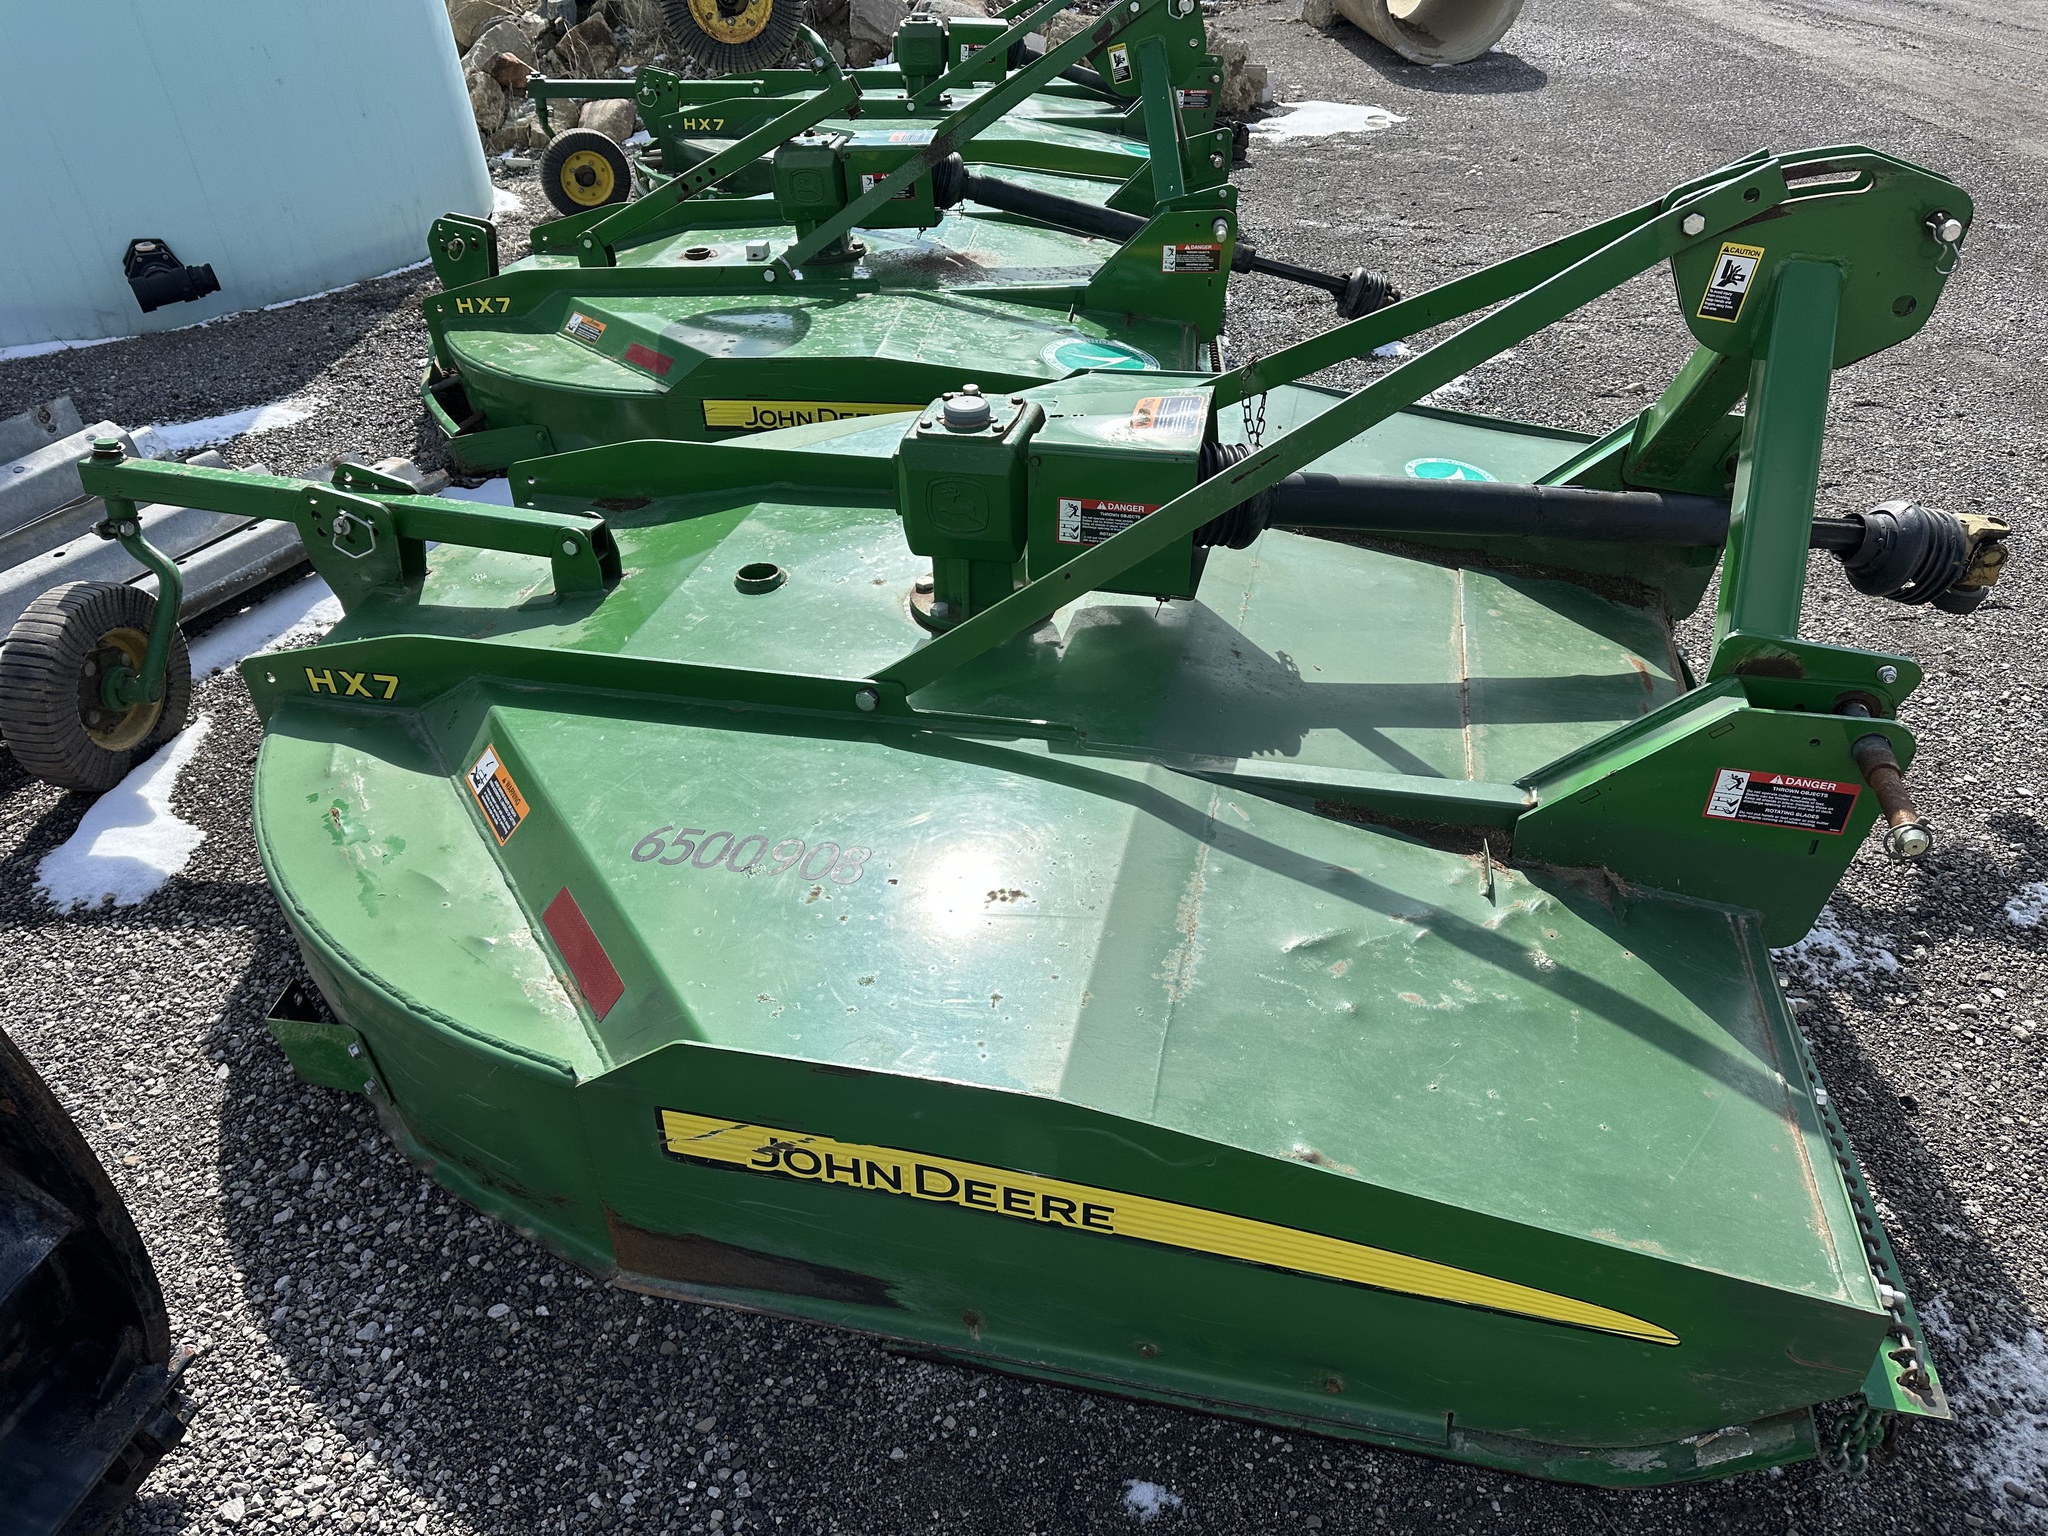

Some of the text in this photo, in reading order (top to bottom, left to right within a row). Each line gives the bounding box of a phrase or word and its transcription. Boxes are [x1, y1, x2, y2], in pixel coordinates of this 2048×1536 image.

[683, 118, 724, 130] HX7
[1730, 246, 1761, 257] CAUTION
[456, 297, 510, 314] HX7
[745, 406, 812, 426] JOHN
[1108, 502, 1144, 512] DANGER
[304, 668, 398, 699] HX7
[1785, 777, 1836, 790] DANGER
[504, 782, 520, 806] WARNING
[1800, 790, 1828, 798] OBJECTS
[1764, 808, 1794, 816] ROTATING
[630, 825, 872, 884] 6500908
[750, 1137, 1116, 1232] JOHN DEERE
